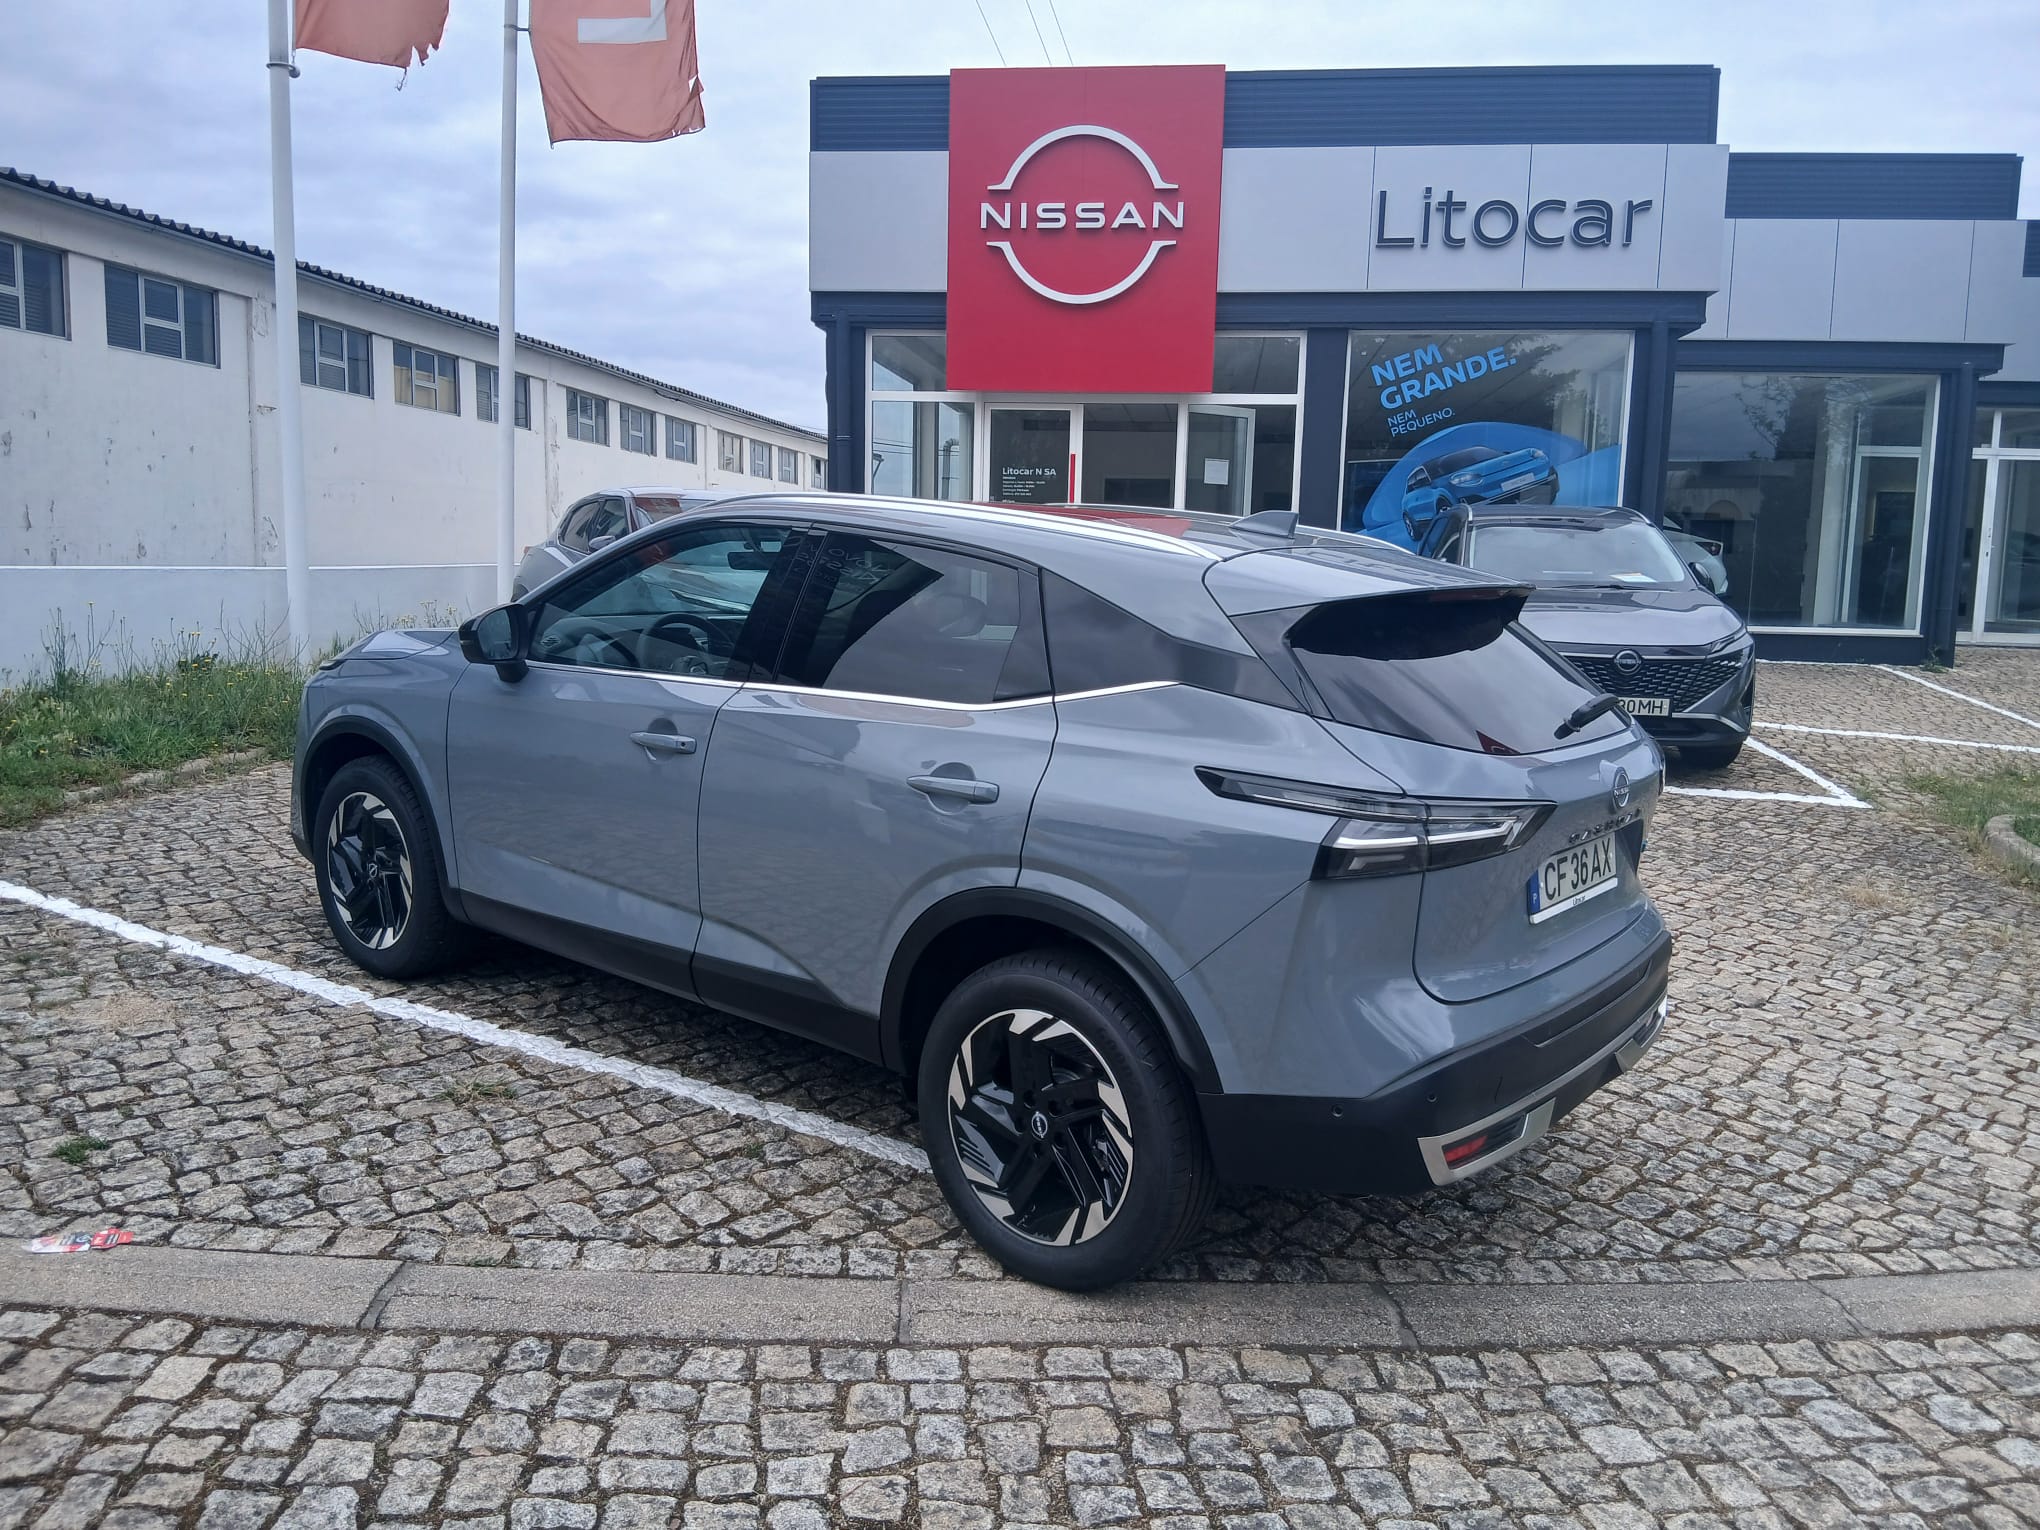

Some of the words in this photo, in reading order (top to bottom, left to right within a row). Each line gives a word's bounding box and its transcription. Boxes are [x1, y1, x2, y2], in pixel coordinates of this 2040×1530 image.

[980, 201, 1185, 230] NISSAN
[1376, 186, 1653, 248] Litocar
[1371, 343, 1444, 386] NEM
[1380, 346, 1517, 409] GRANDE.
[1388, 409, 1417, 427] NEM
[1390, 407, 1456, 437] PEQUENO.
[1002, 467, 1034, 476] Litocar
[1035, 468, 1042, 476] N
[1044, 468, 1057, 476] SA
